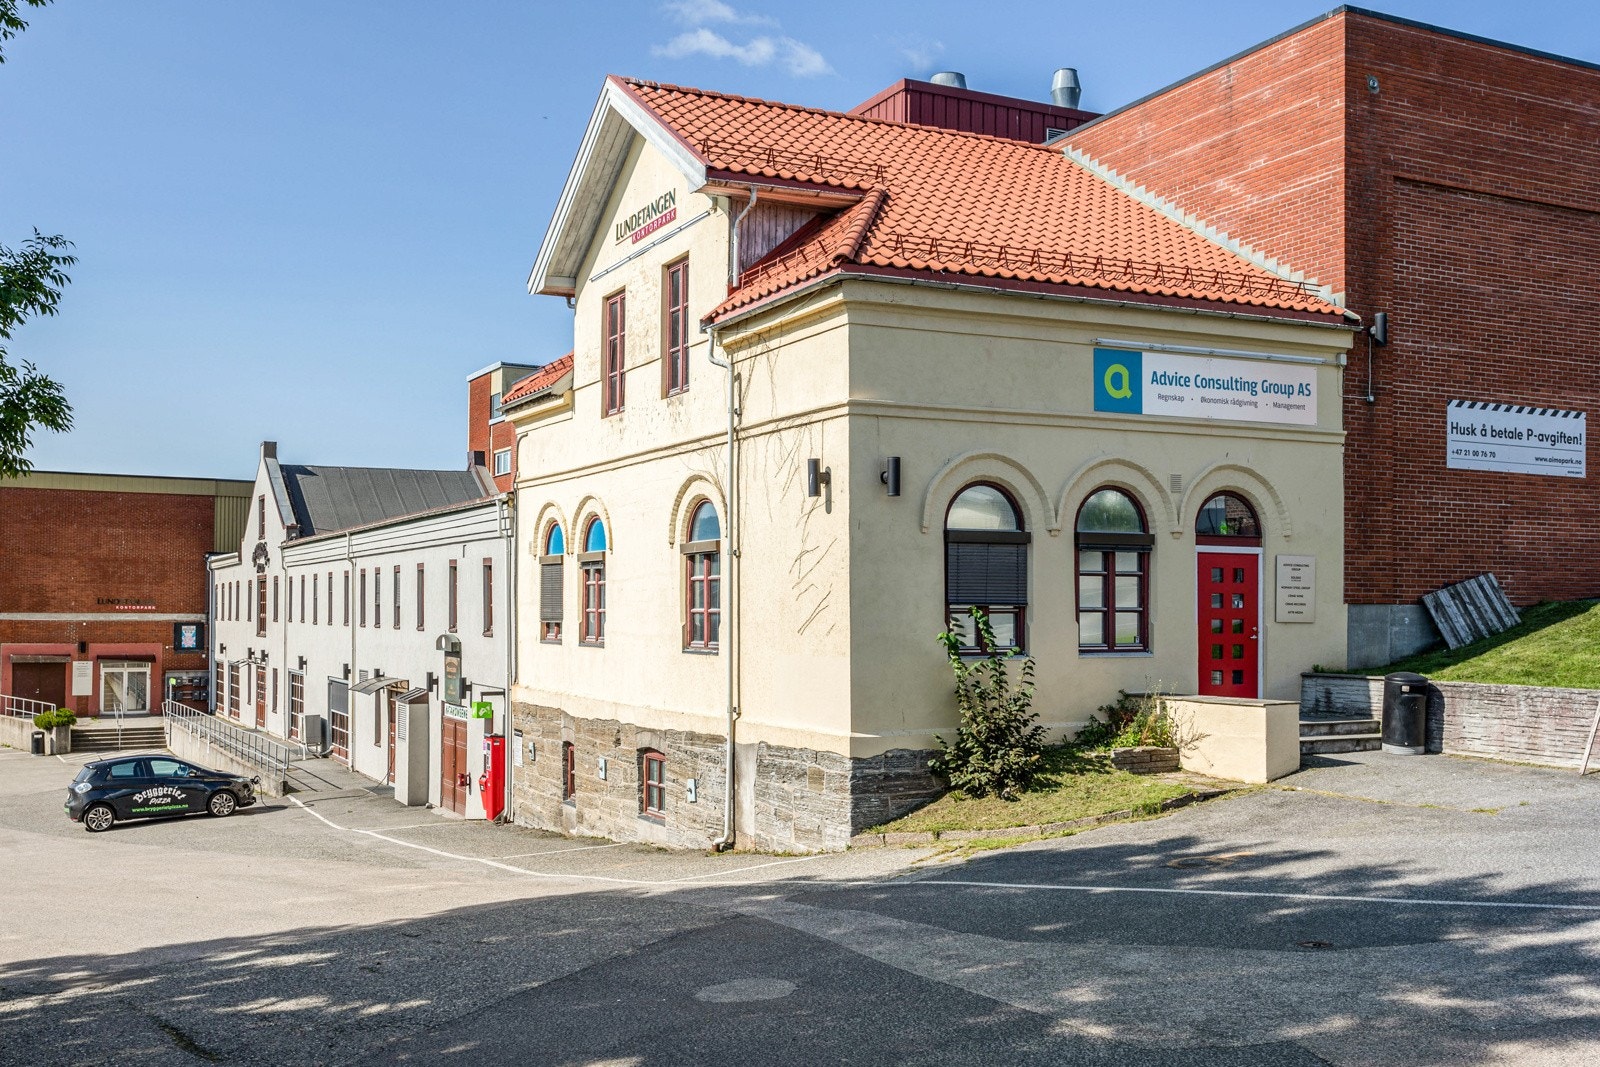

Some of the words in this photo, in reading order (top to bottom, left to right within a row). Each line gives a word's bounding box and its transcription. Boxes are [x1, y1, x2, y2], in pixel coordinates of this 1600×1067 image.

[616, 188, 676, 241] LUNDETANGEN
[632, 211, 675, 244] KONTORPARK
[1151, 371, 1190, 388] Advice
[1194, 374, 1258, 395] Consulting
[1261, 379, 1295, 398] Group
[1297, 383, 1312, 397] AS
[1157, 393, 1185, 403] Regnskap
[1200, 396, 1229, 406] Økonomisk
[1230, 398, 1258, 409] rådgivning
[1273, 401, 1306, 411] Management
[1450, 421, 1477, 437] Husk
[1480, 423, 1487, 437] å
[1490, 425, 1523, 440] betale
[1526, 428, 1582, 446] P-avgiften!
[132, 785, 187, 803] Bryggeriet
